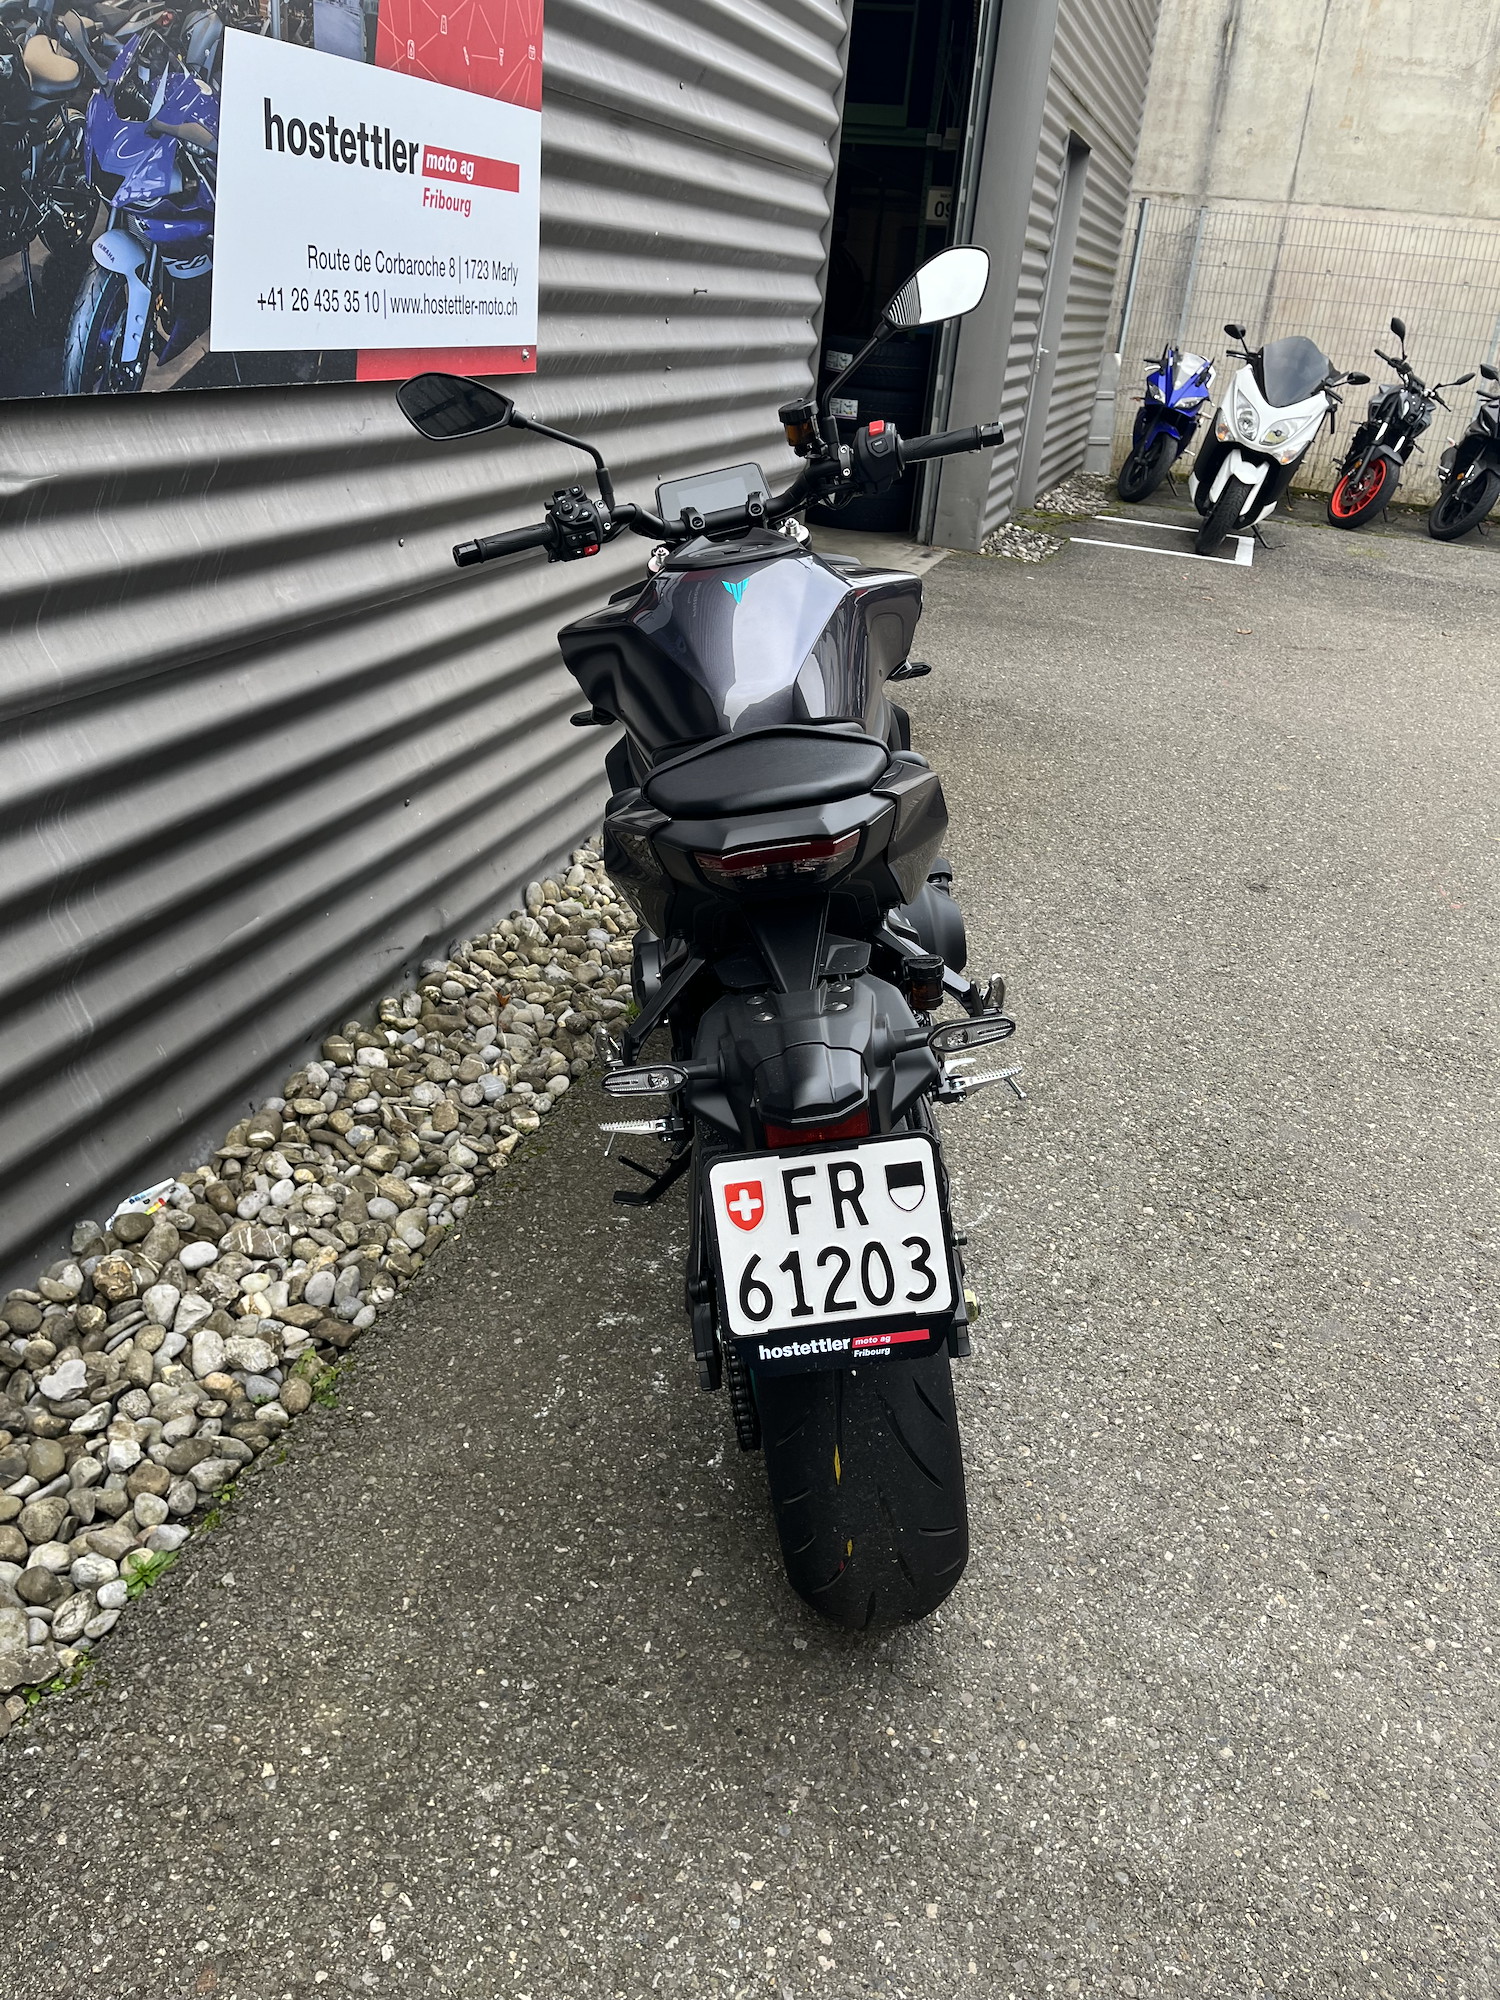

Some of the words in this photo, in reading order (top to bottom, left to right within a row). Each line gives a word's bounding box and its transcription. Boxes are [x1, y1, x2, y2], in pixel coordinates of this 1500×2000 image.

[264, 97, 419, 174] hostettler
[426, 153, 458, 173] moto
[460, 160, 475, 181] ag
[422, 187, 471, 217] Fribourg
[308, 244, 350, 271] Route
[355, 249, 371, 272] de
[375, 250, 446, 277] Corbaroche
[448, 257, 456, 278] 8
[464, 258, 489, 280] 1723
[492, 260, 519, 287] Marly
[257, 286, 284, 311] +41
[291, 287, 309, 312] 26
[314, 289, 340, 313] 435
[344, 290, 360, 313] 35
[364, 291, 380, 313] 10
[390, 293, 518, 316] www.hostettler-moto.ch
[781, 1161, 869, 1235] FR
[739, 1235, 937, 1322] 61203
[759, 1338, 851, 1360] hostettler
[854, 1337, 878, 1346] moto
[880, 1335, 891, 1344] ag
[853, 1346, 891, 1358] Fribourg
